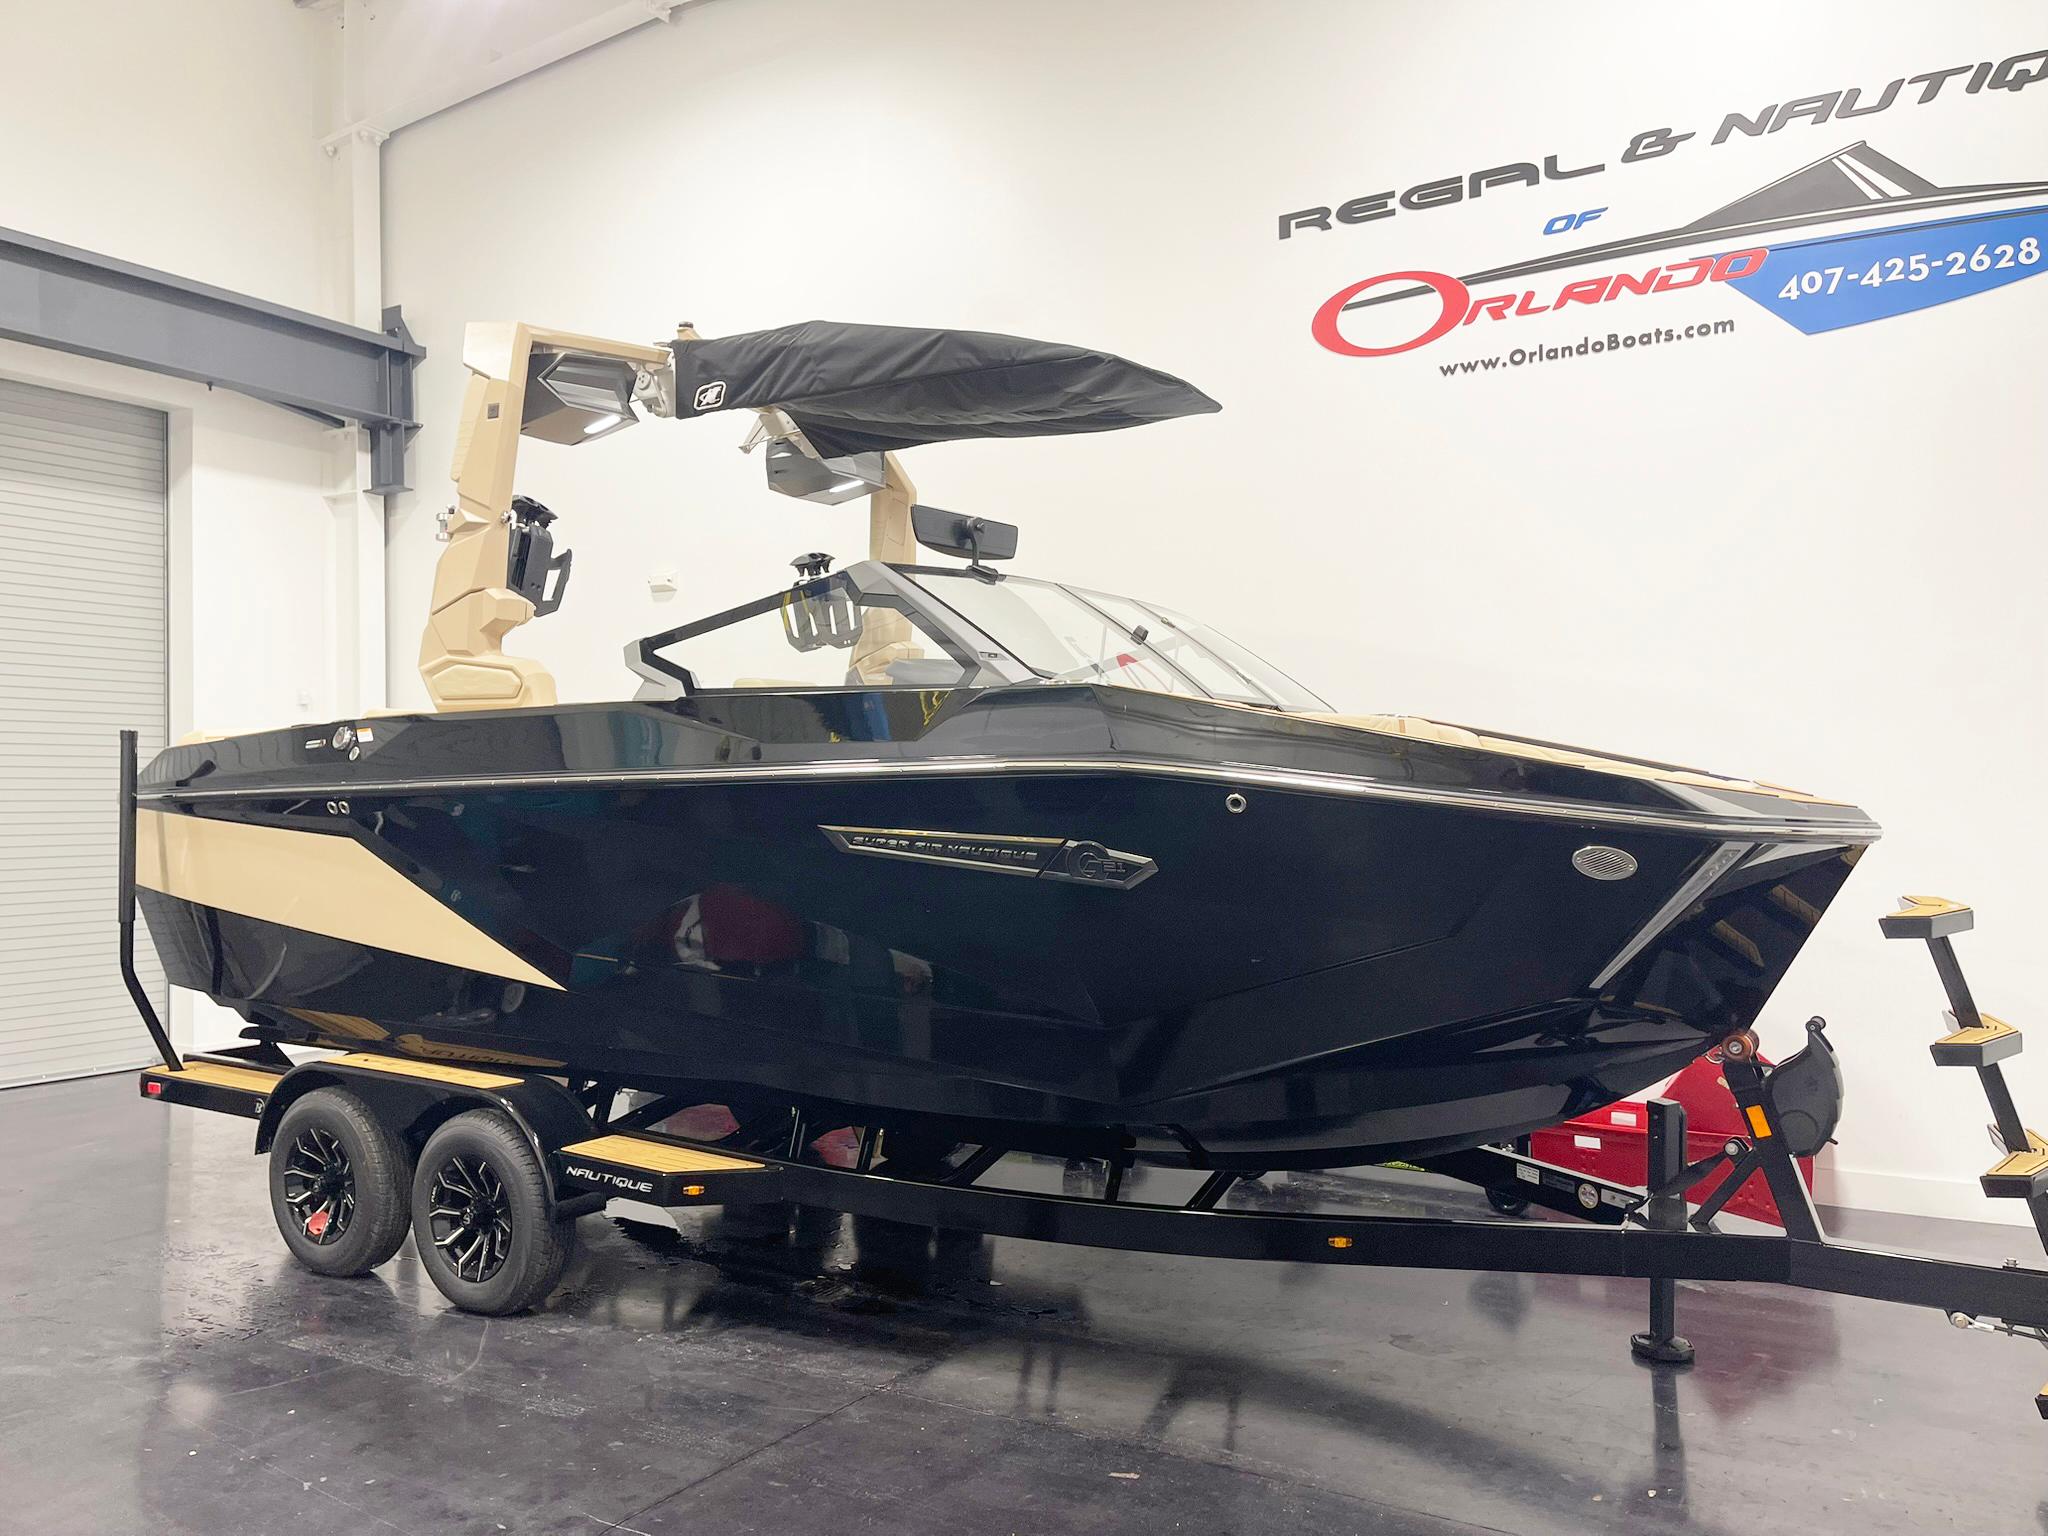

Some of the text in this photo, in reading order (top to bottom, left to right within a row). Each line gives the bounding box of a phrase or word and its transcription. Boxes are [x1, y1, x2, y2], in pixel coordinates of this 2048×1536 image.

[1278, 49, 2048, 240] REGAL & NAUTIQ
[1542, 206, 1609, 235] OF
[1778, 236, 2041, 301] 407-425-2628
[1439, 316, 1736, 378] www.OrlandoBoats.com
[565, 1165, 654, 1193] NAUTIQUE
